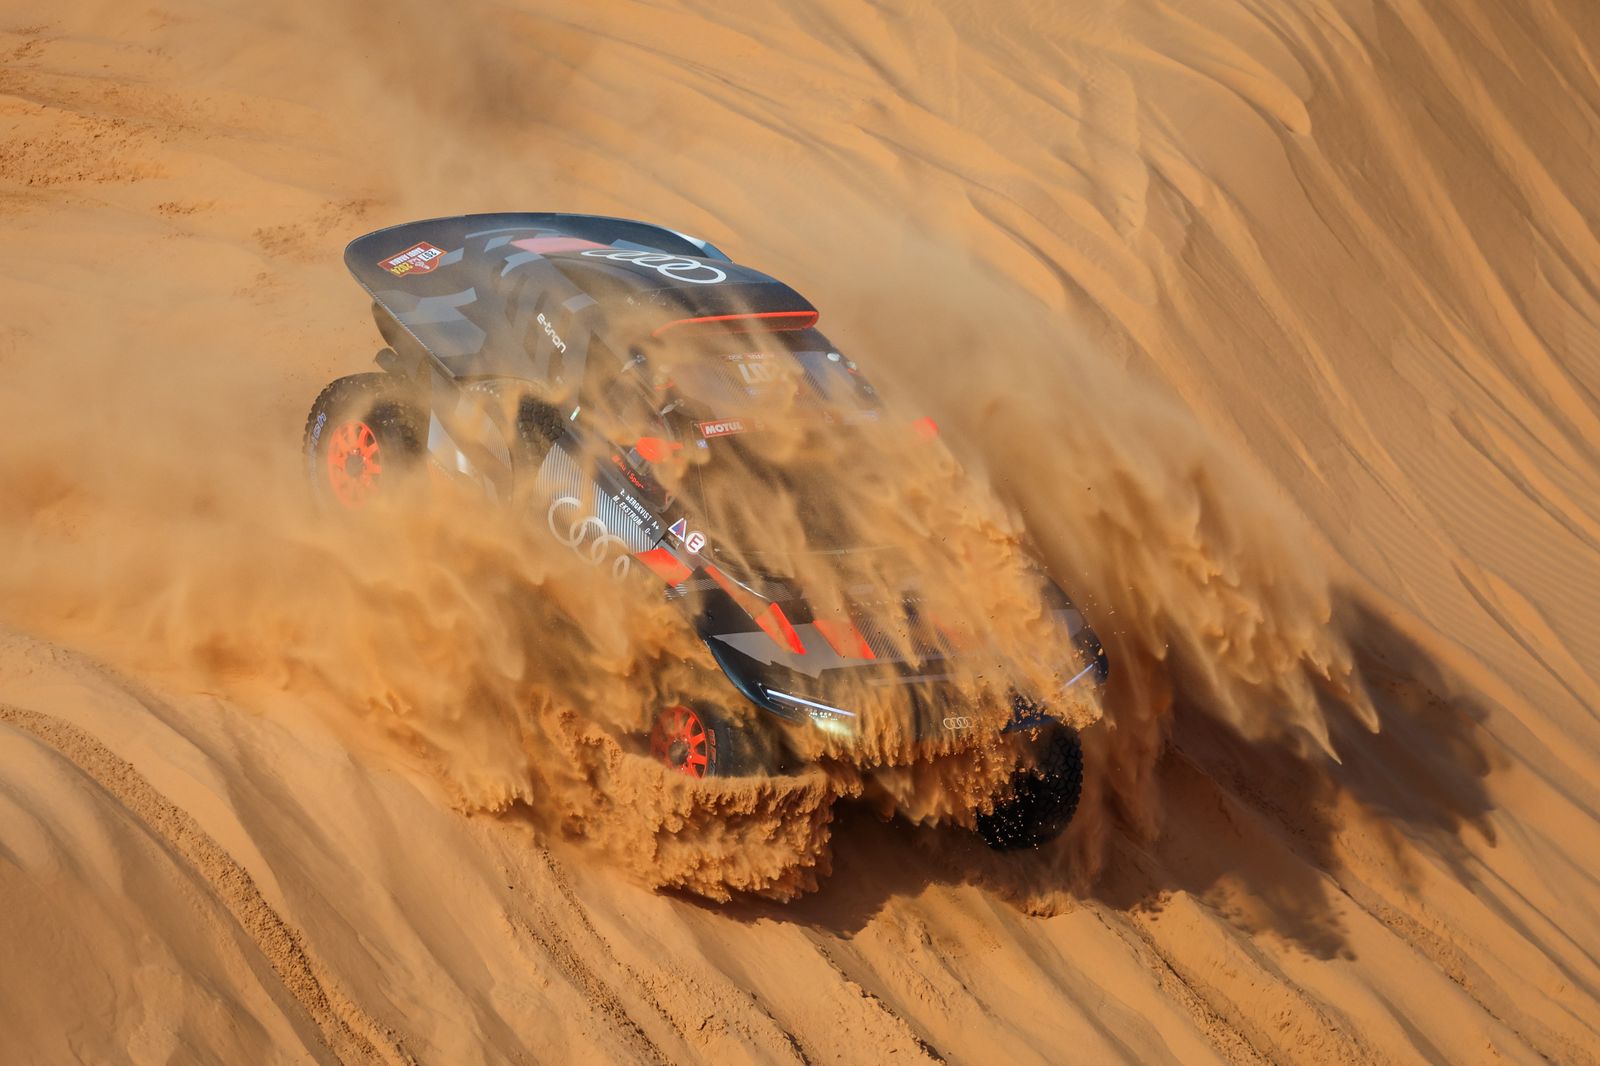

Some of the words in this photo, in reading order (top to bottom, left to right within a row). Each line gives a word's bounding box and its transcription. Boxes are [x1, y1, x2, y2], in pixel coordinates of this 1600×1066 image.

[536, 312, 566, 354] e-tron
[704, 421, 743, 435] MOTUL
[688, 534, 703, 551] E
